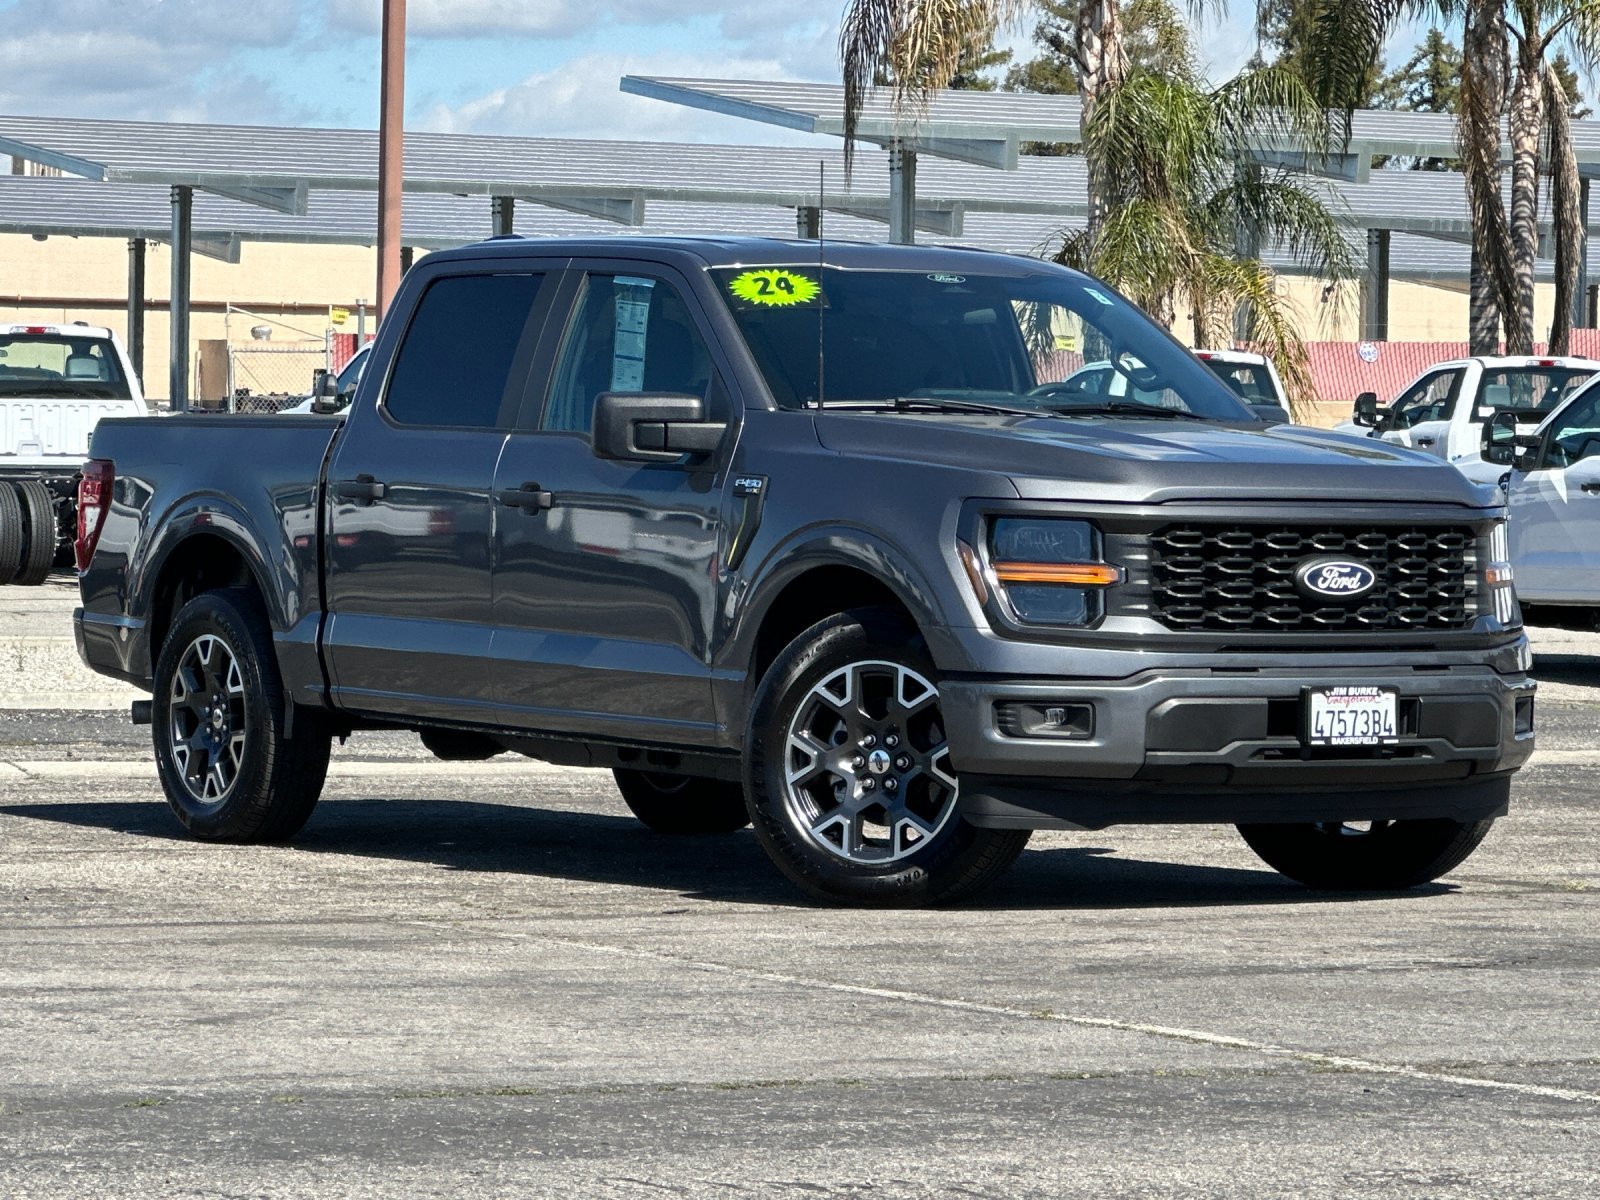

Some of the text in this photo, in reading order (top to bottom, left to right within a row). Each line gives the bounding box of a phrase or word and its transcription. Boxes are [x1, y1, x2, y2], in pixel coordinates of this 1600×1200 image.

[934, 273, 960, 283] Ford
[752, 276, 795, 296] 24
[1317, 565, 1362, 589] Ford
[1331, 687, 1379, 696] JIM BURKE
[1331, 736, 1378, 745] BAKERSFIELD
